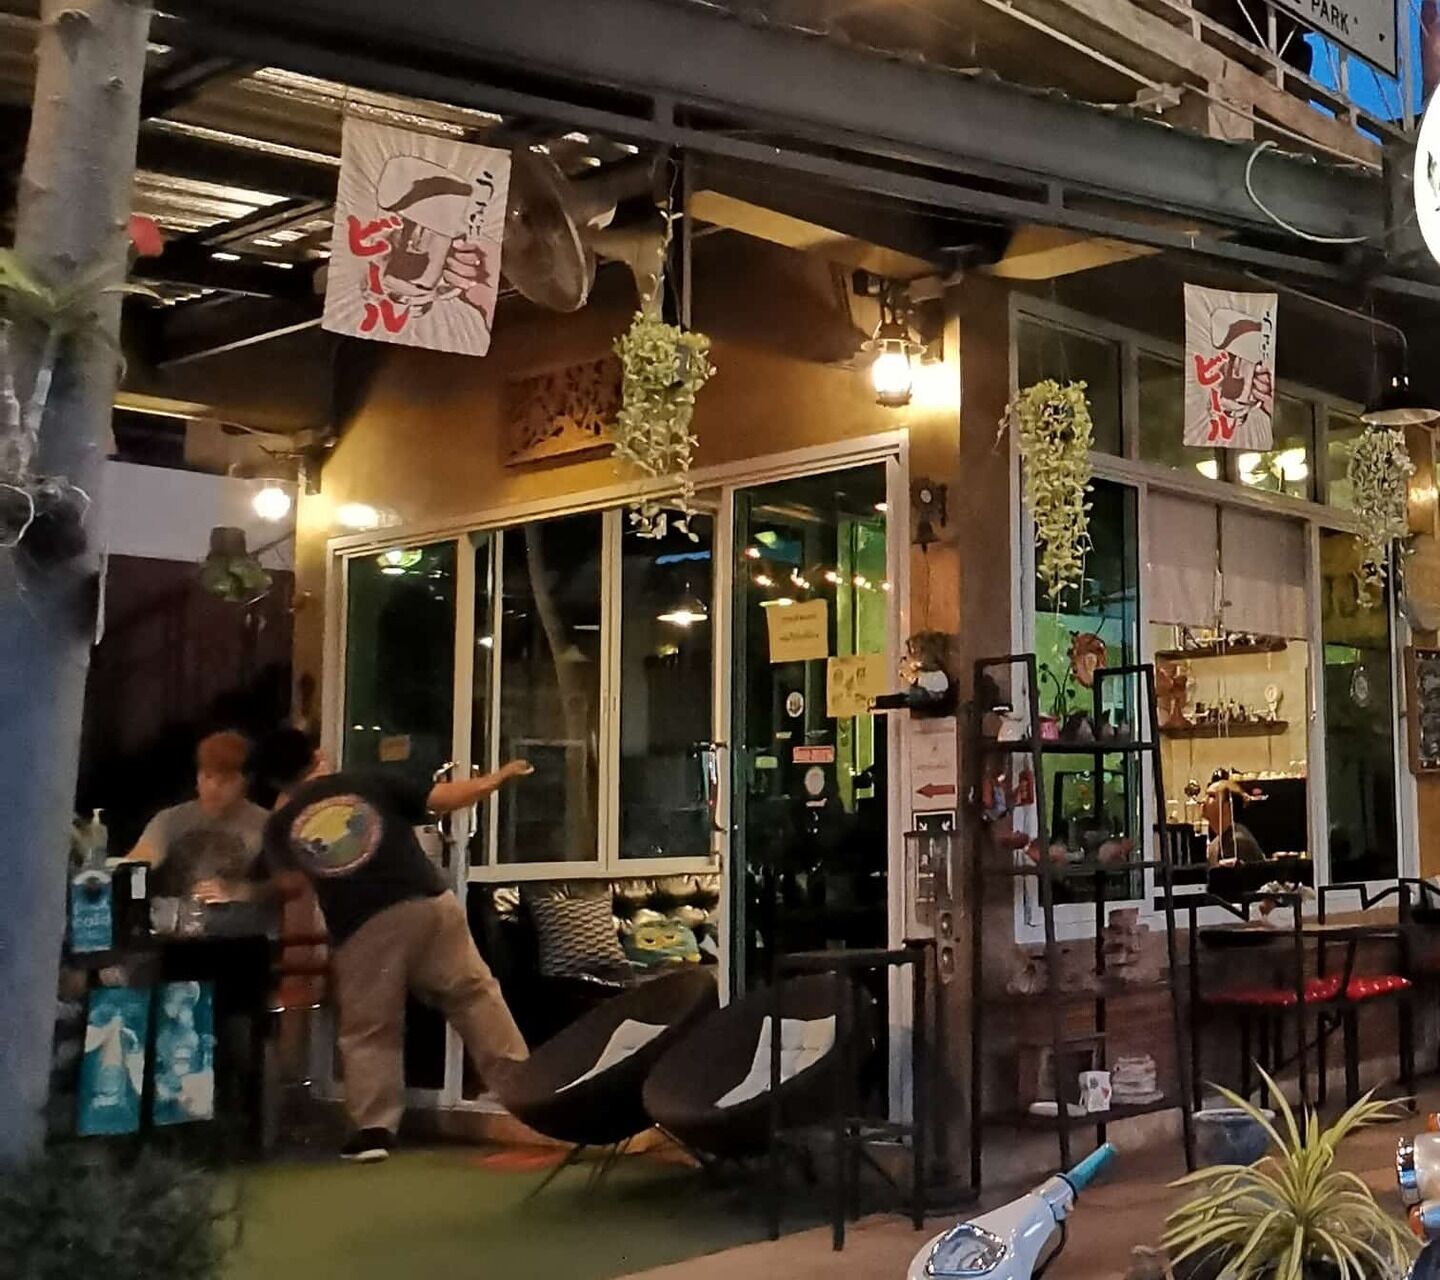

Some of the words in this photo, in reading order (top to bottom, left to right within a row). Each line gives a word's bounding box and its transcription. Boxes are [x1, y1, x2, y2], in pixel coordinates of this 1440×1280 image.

[346, 214, 409, 333] ビール
[1194, 351, 1236, 441] ビール
